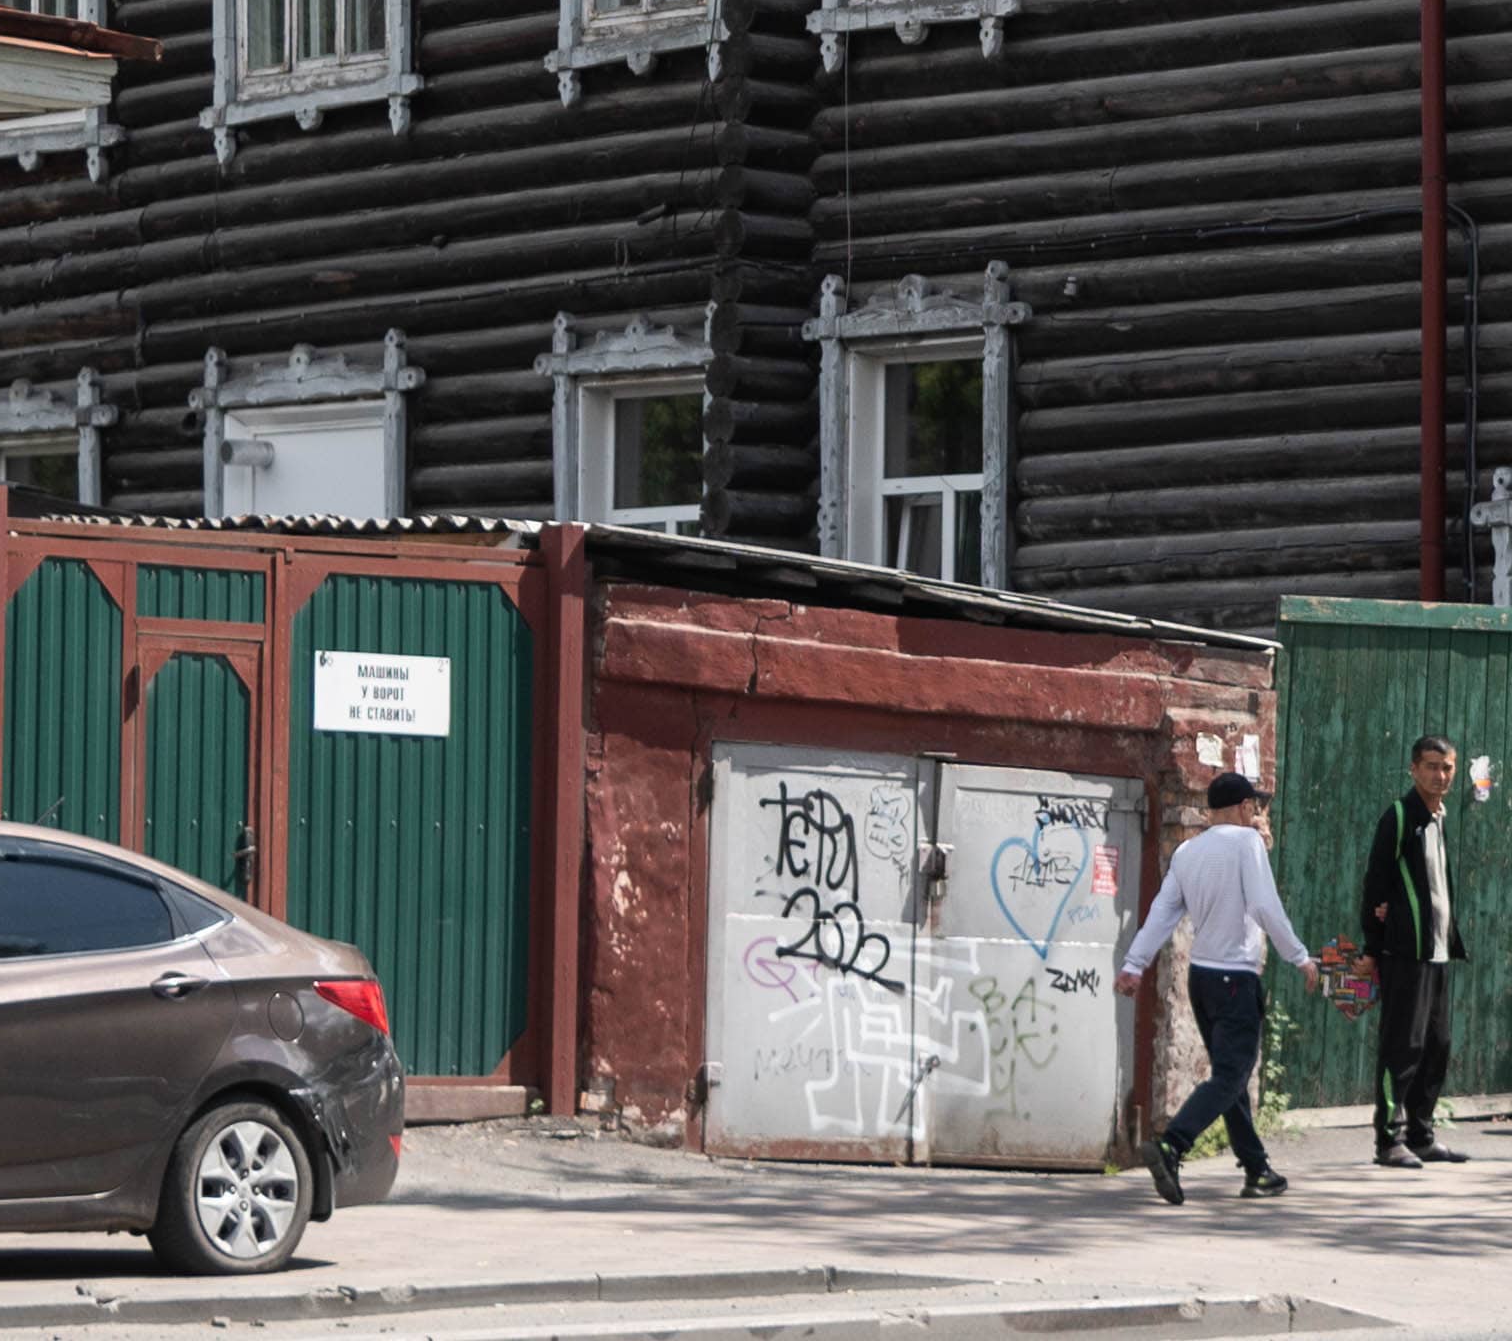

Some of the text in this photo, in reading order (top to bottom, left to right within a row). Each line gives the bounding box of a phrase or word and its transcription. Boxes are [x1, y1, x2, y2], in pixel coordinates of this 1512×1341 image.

[358, 664, 409, 680] МАШИНЫ
[361, 685, 404, 701] У ВОРОТ
[349, 705, 416, 722] НЕ СТАВИТЬ!
